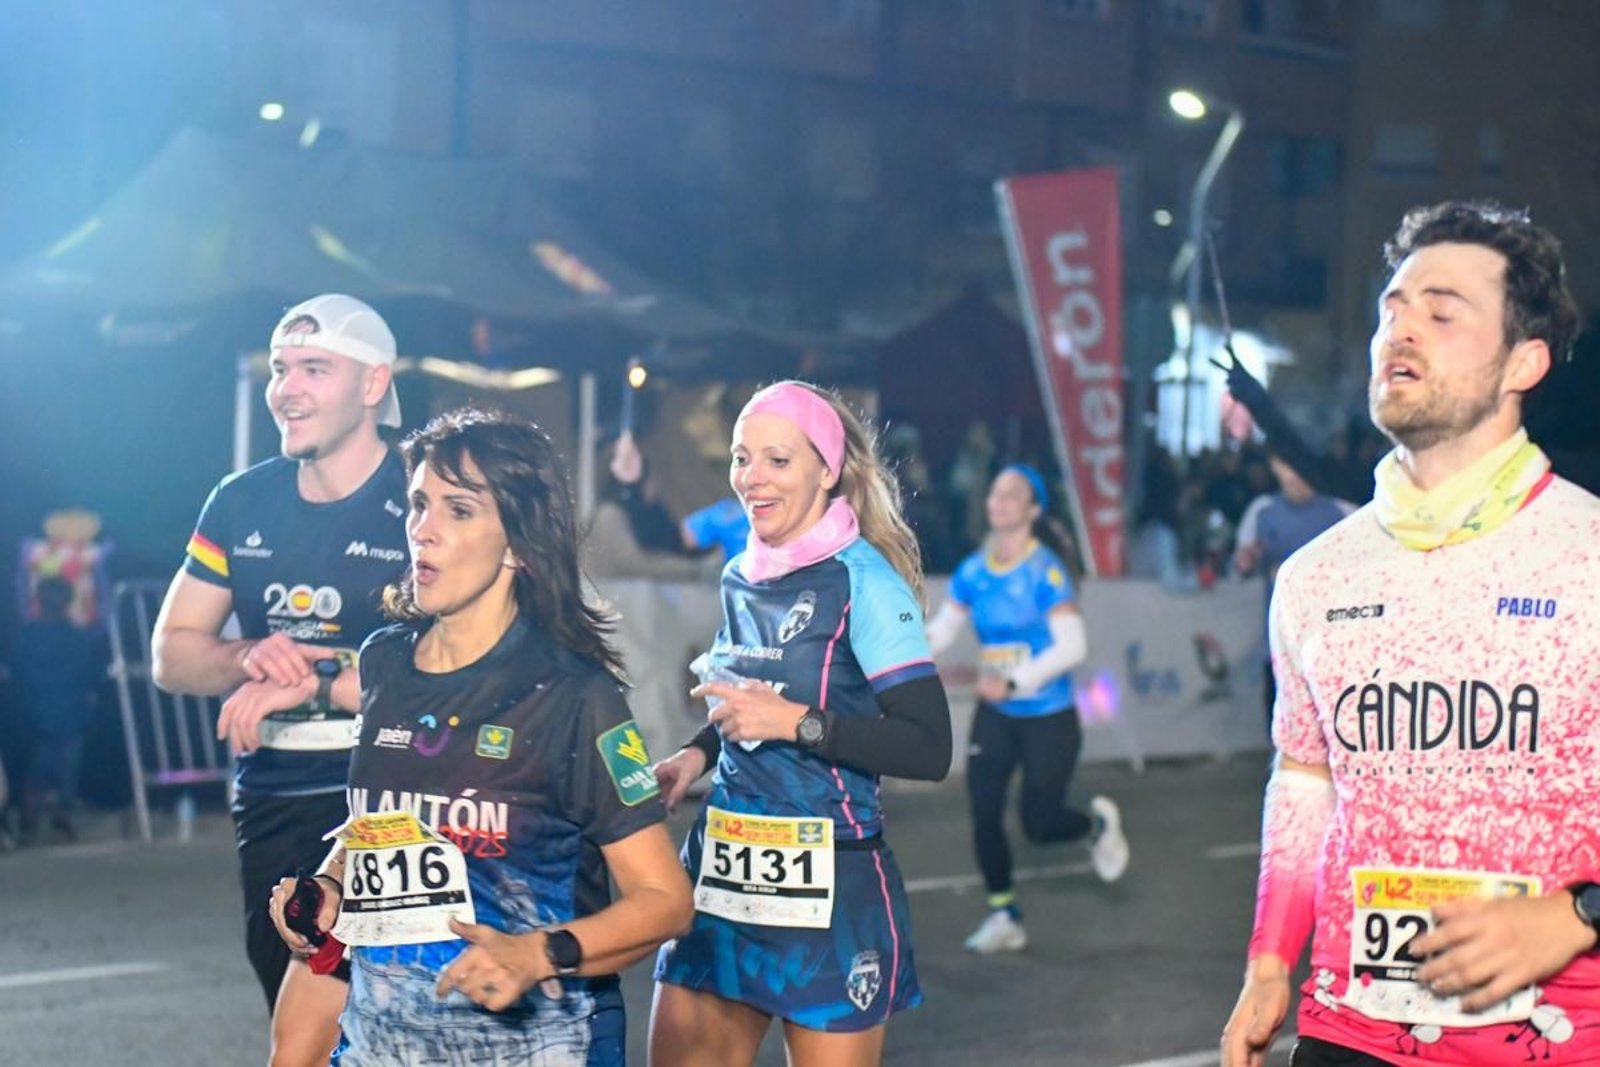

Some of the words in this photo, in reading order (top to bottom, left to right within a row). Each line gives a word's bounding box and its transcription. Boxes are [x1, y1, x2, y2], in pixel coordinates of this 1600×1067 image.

[263, 583, 342, 620] 200
[1496, 596, 1557, 618] PABLO
[1333, 668, 1540, 753] CÁNDIDA
[377, 788, 508, 839] ANTÓN
[714, 841, 812, 885] 5131
[1385, 877, 1414, 900] 42
